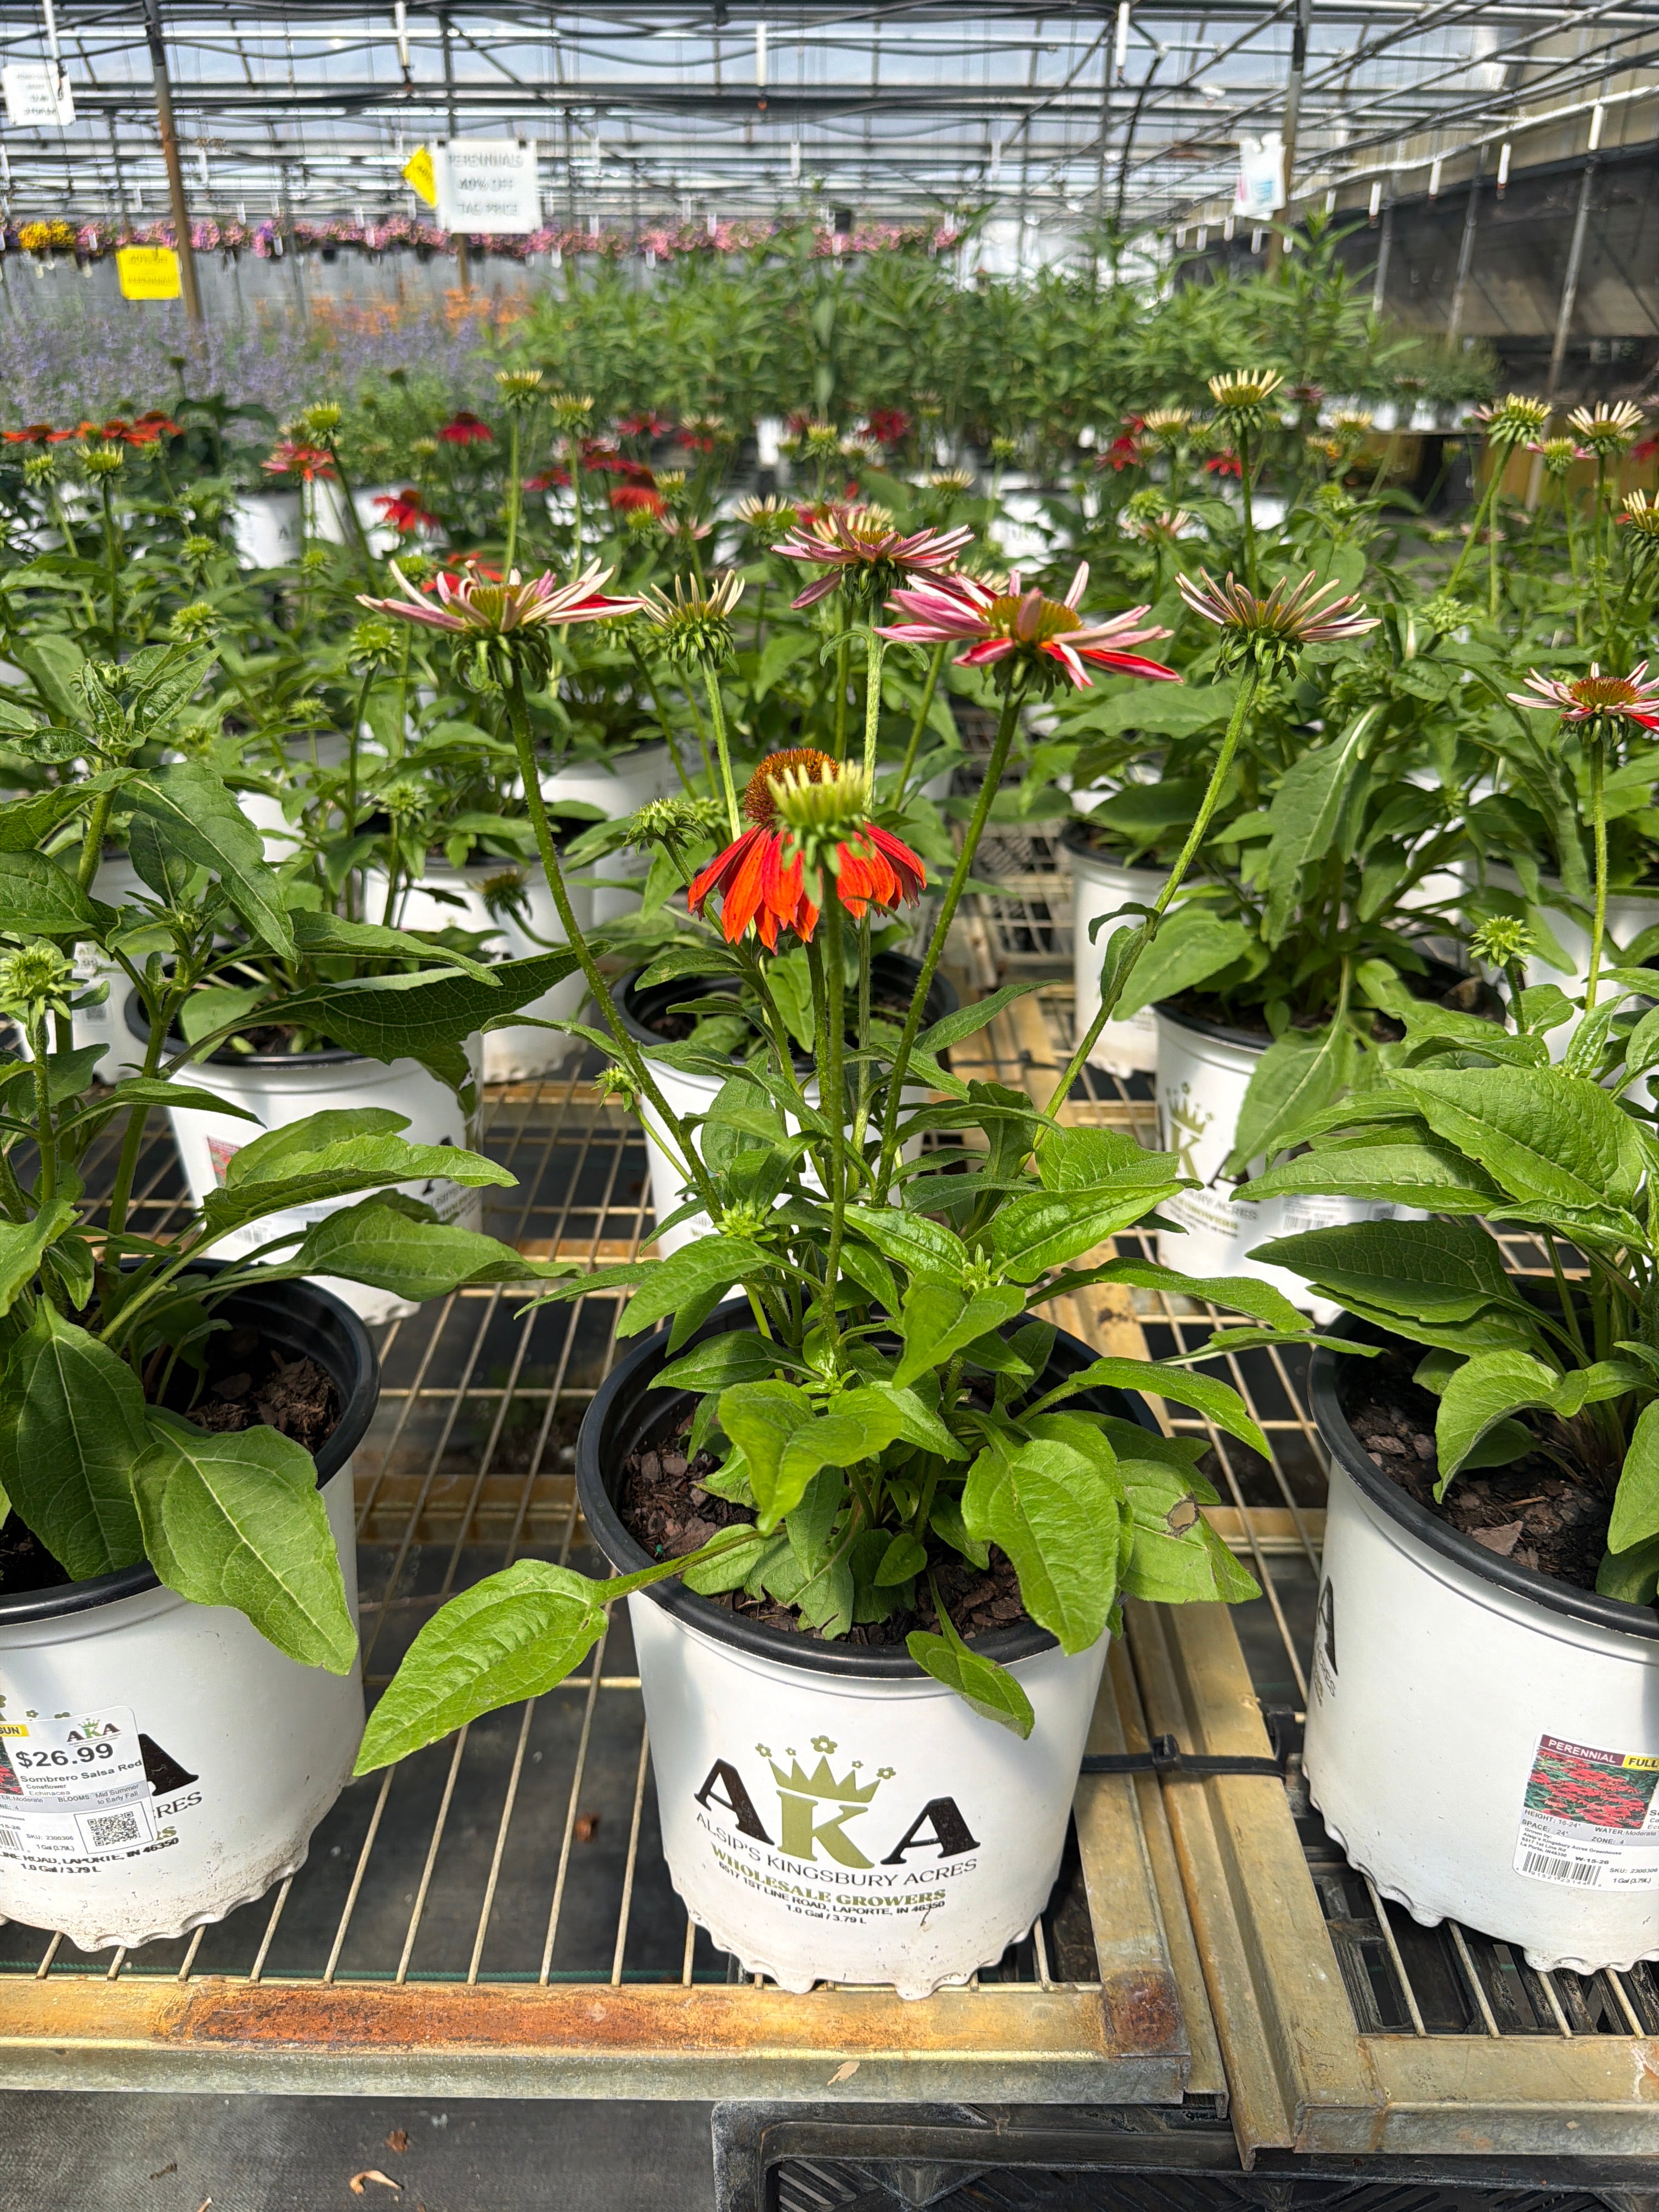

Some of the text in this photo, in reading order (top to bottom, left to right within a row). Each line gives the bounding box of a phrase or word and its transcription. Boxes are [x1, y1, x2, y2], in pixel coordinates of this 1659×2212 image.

[66, 1723, 121, 1742] AKA
[15, 1743, 113, 1769] $26.99
[1548, 1739, 1659, 1768] PERENNIAL FULL
[81, 1768, 115, 1779] Salsa
[118, 1759, 142, 1771] Red
[106, 1795, 123, 1804] Early
[126, 1790, 138, 1798] Fall
[110, 1784, 139, 1795] Summer
[154, 1791, 202, 1819] RES
[694, 1758, 981, 1870] AKA
[1525, 1809, 1556, 1823] HEIGHT:
[1522, 1819, 1551, 1833] SPACE:
[1525, 1827, 1542, 1836] Grown
[143, 1837, 179, 1853] 46350
[696, 1812, 978, 1887] ALSIP'S KINGSBURY ACRES
[1543, 1838, 1571, 1848] Kingsbury
[1591, 1836, 1615, 1844] ZONE:
[1576, 1856, 1609, 1865] W-15-26
[710, 1842, 946, 1906] WHOLESALE GROWERS
[743, 1877, 761, 1891] 1ST
[764, 1887, 789, 1901] LINE
[792, 1896, 830, 1912] ROAD,
[833, 1905, 893, 1915] LAPORTE,
[911, 1900, 945, 1911] 46350
[786, 1904, 802, 1914] 1.0
[805, 1909, 823, 1918] Gal
[832, 1914, 856, 1923] 3.79
